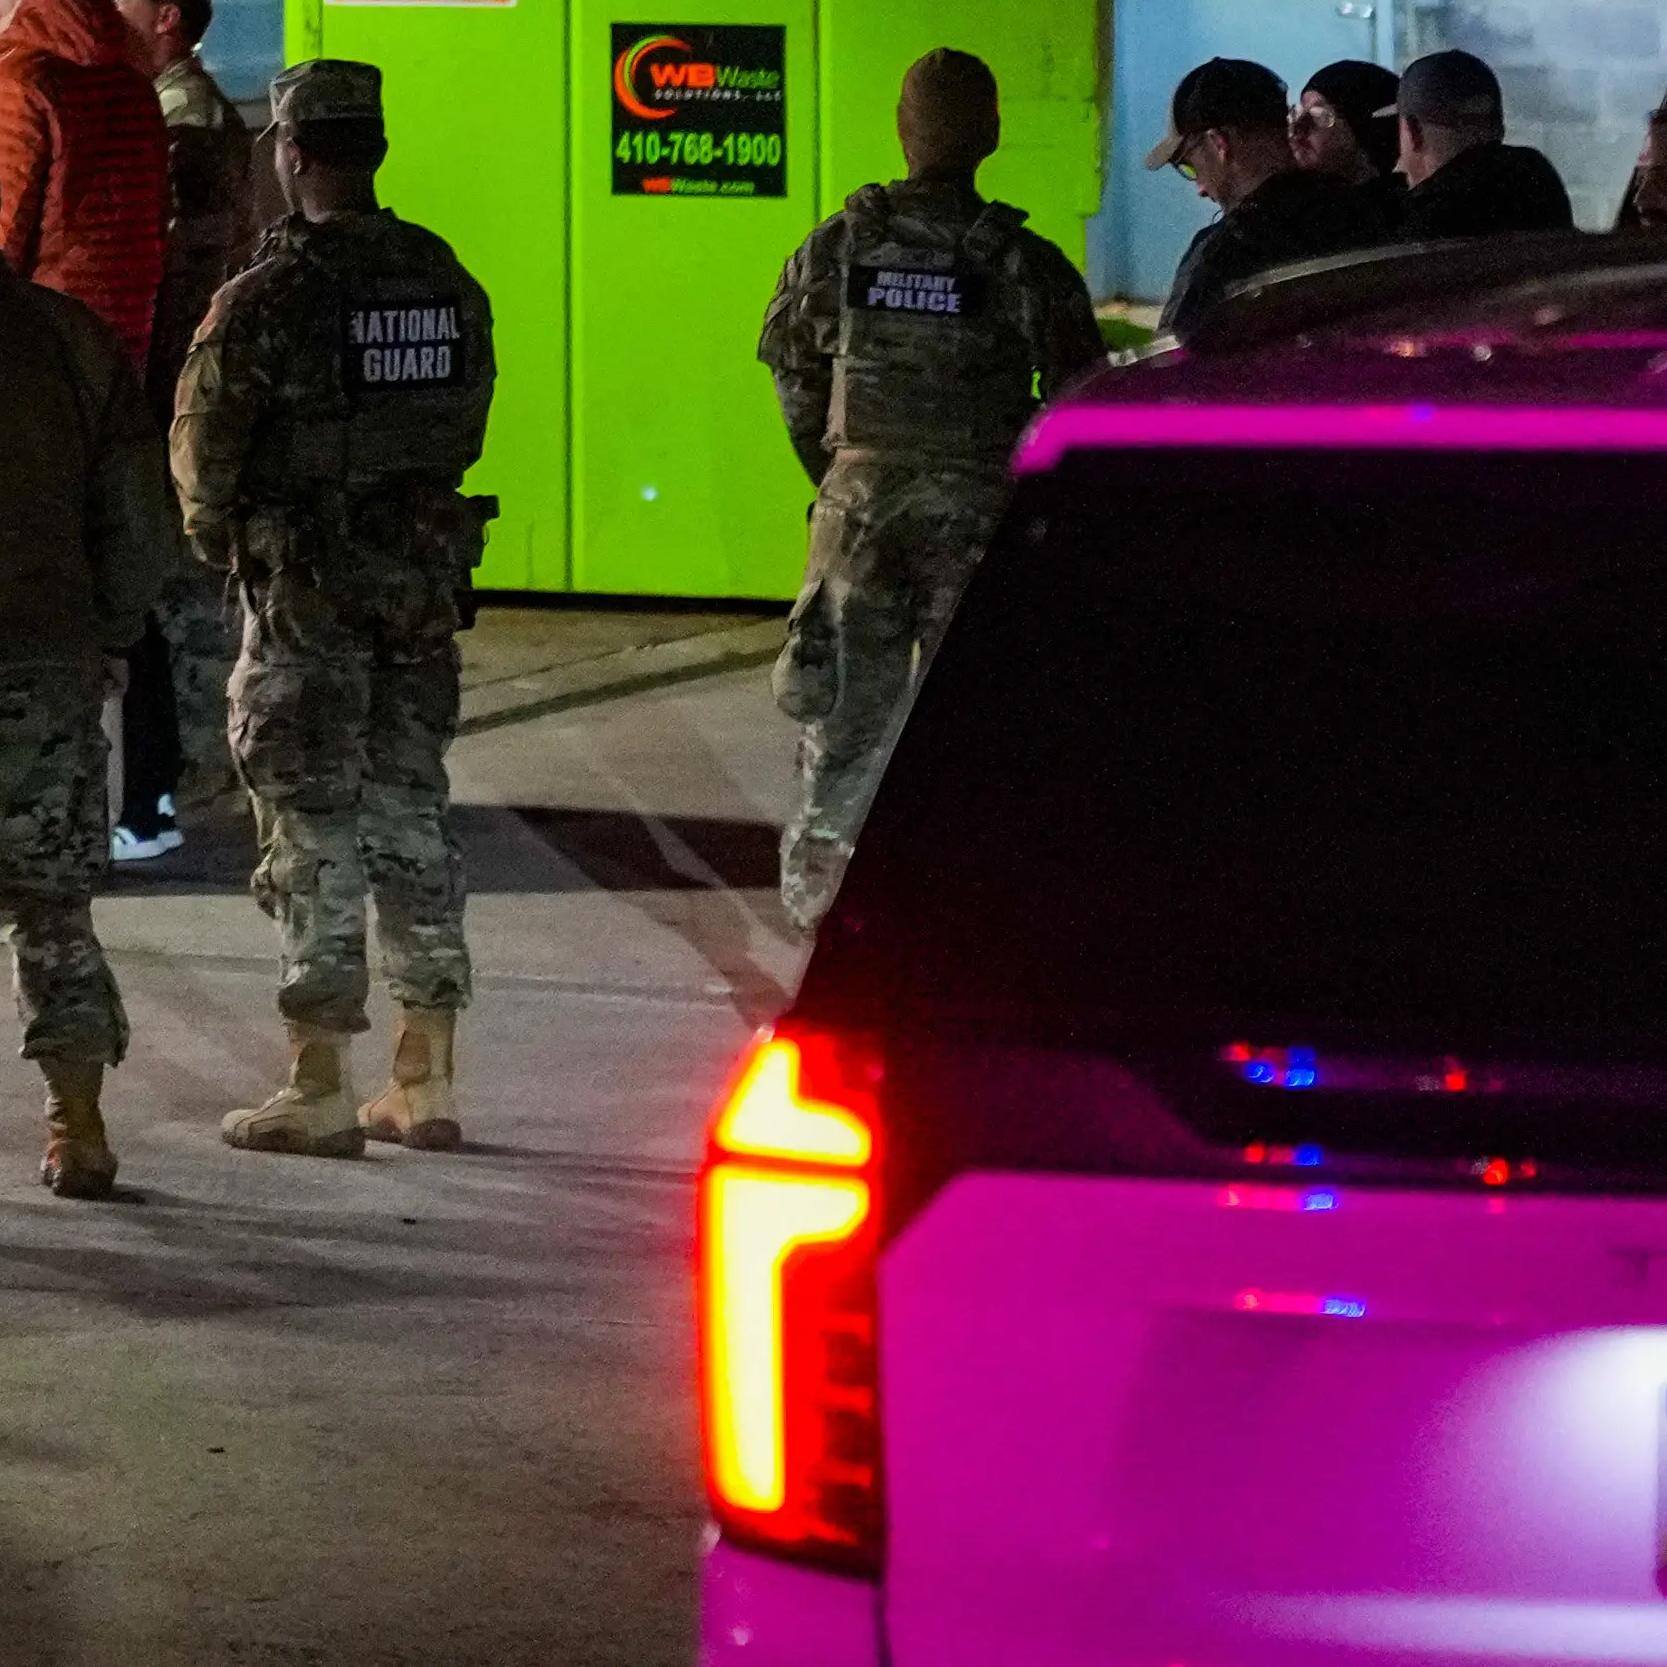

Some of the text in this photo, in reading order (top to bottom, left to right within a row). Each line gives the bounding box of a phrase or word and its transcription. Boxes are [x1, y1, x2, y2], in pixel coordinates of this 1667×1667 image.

[615, 131, 781, 166] 410-768-1900
[876, 270, 956, 292] MILITARY
[867, 286, 961, 313] POLICE
[349, 306, 460, 344] NATIONAL
[363, 345, 451, 382] GUARD
